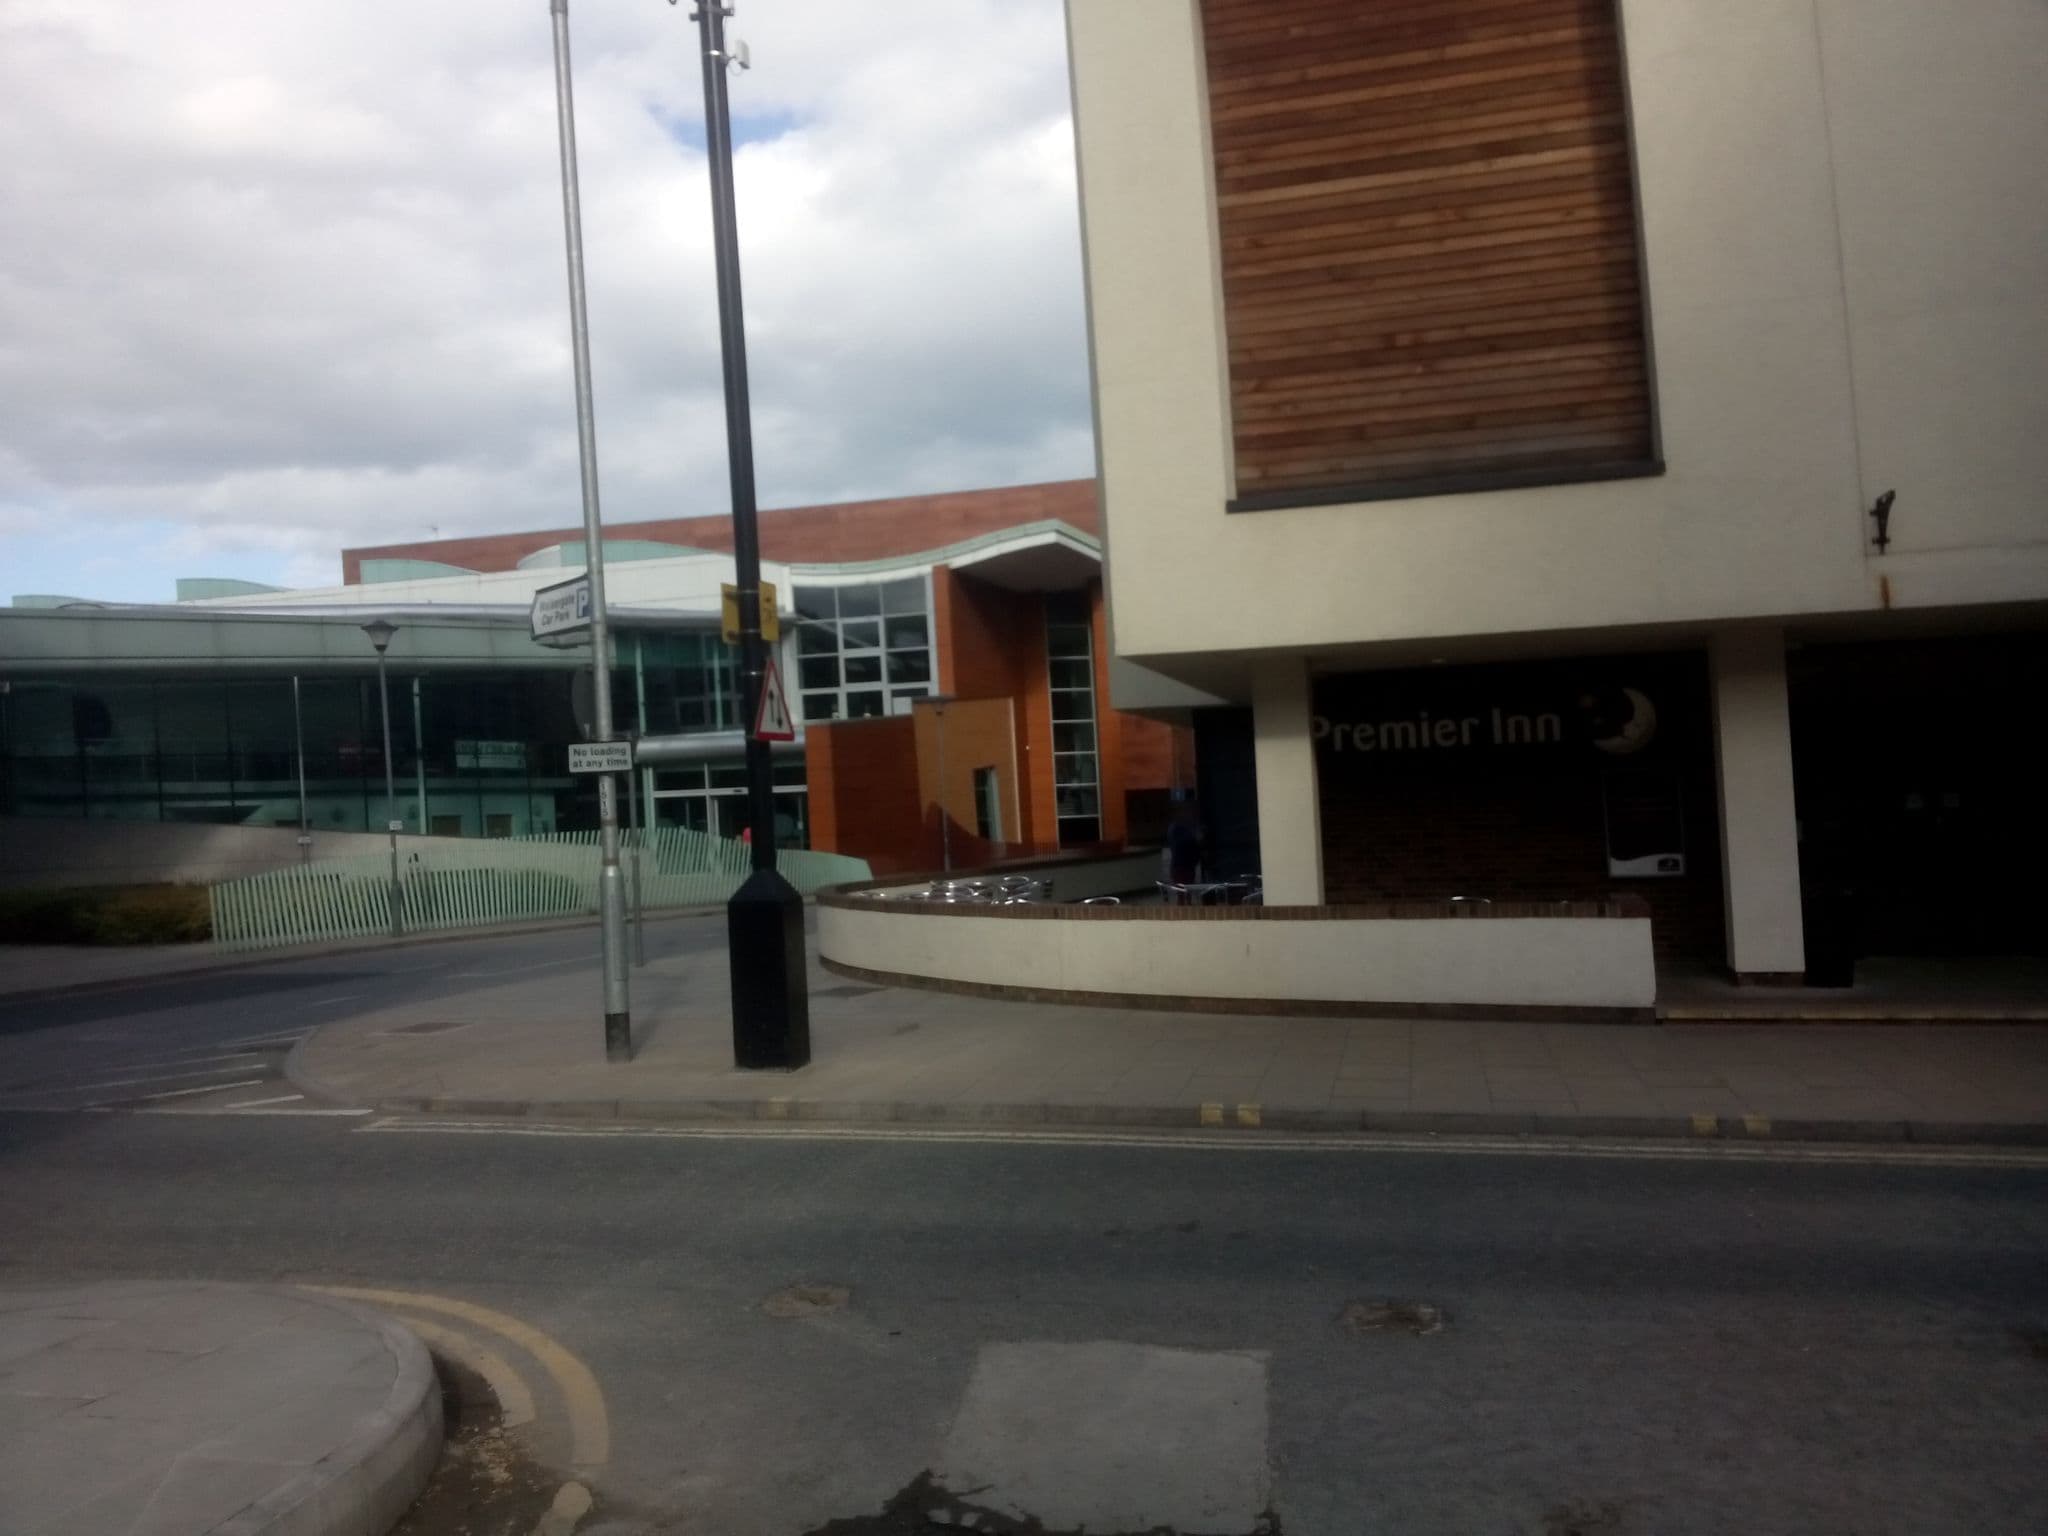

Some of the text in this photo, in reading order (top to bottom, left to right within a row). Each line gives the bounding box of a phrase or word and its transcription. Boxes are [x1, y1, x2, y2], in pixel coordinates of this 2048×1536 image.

[1314, 707, 1561, 752] Premier Inn
[573, 746, 626, 757] No loading
[572, 757, 627, 769] at any time
